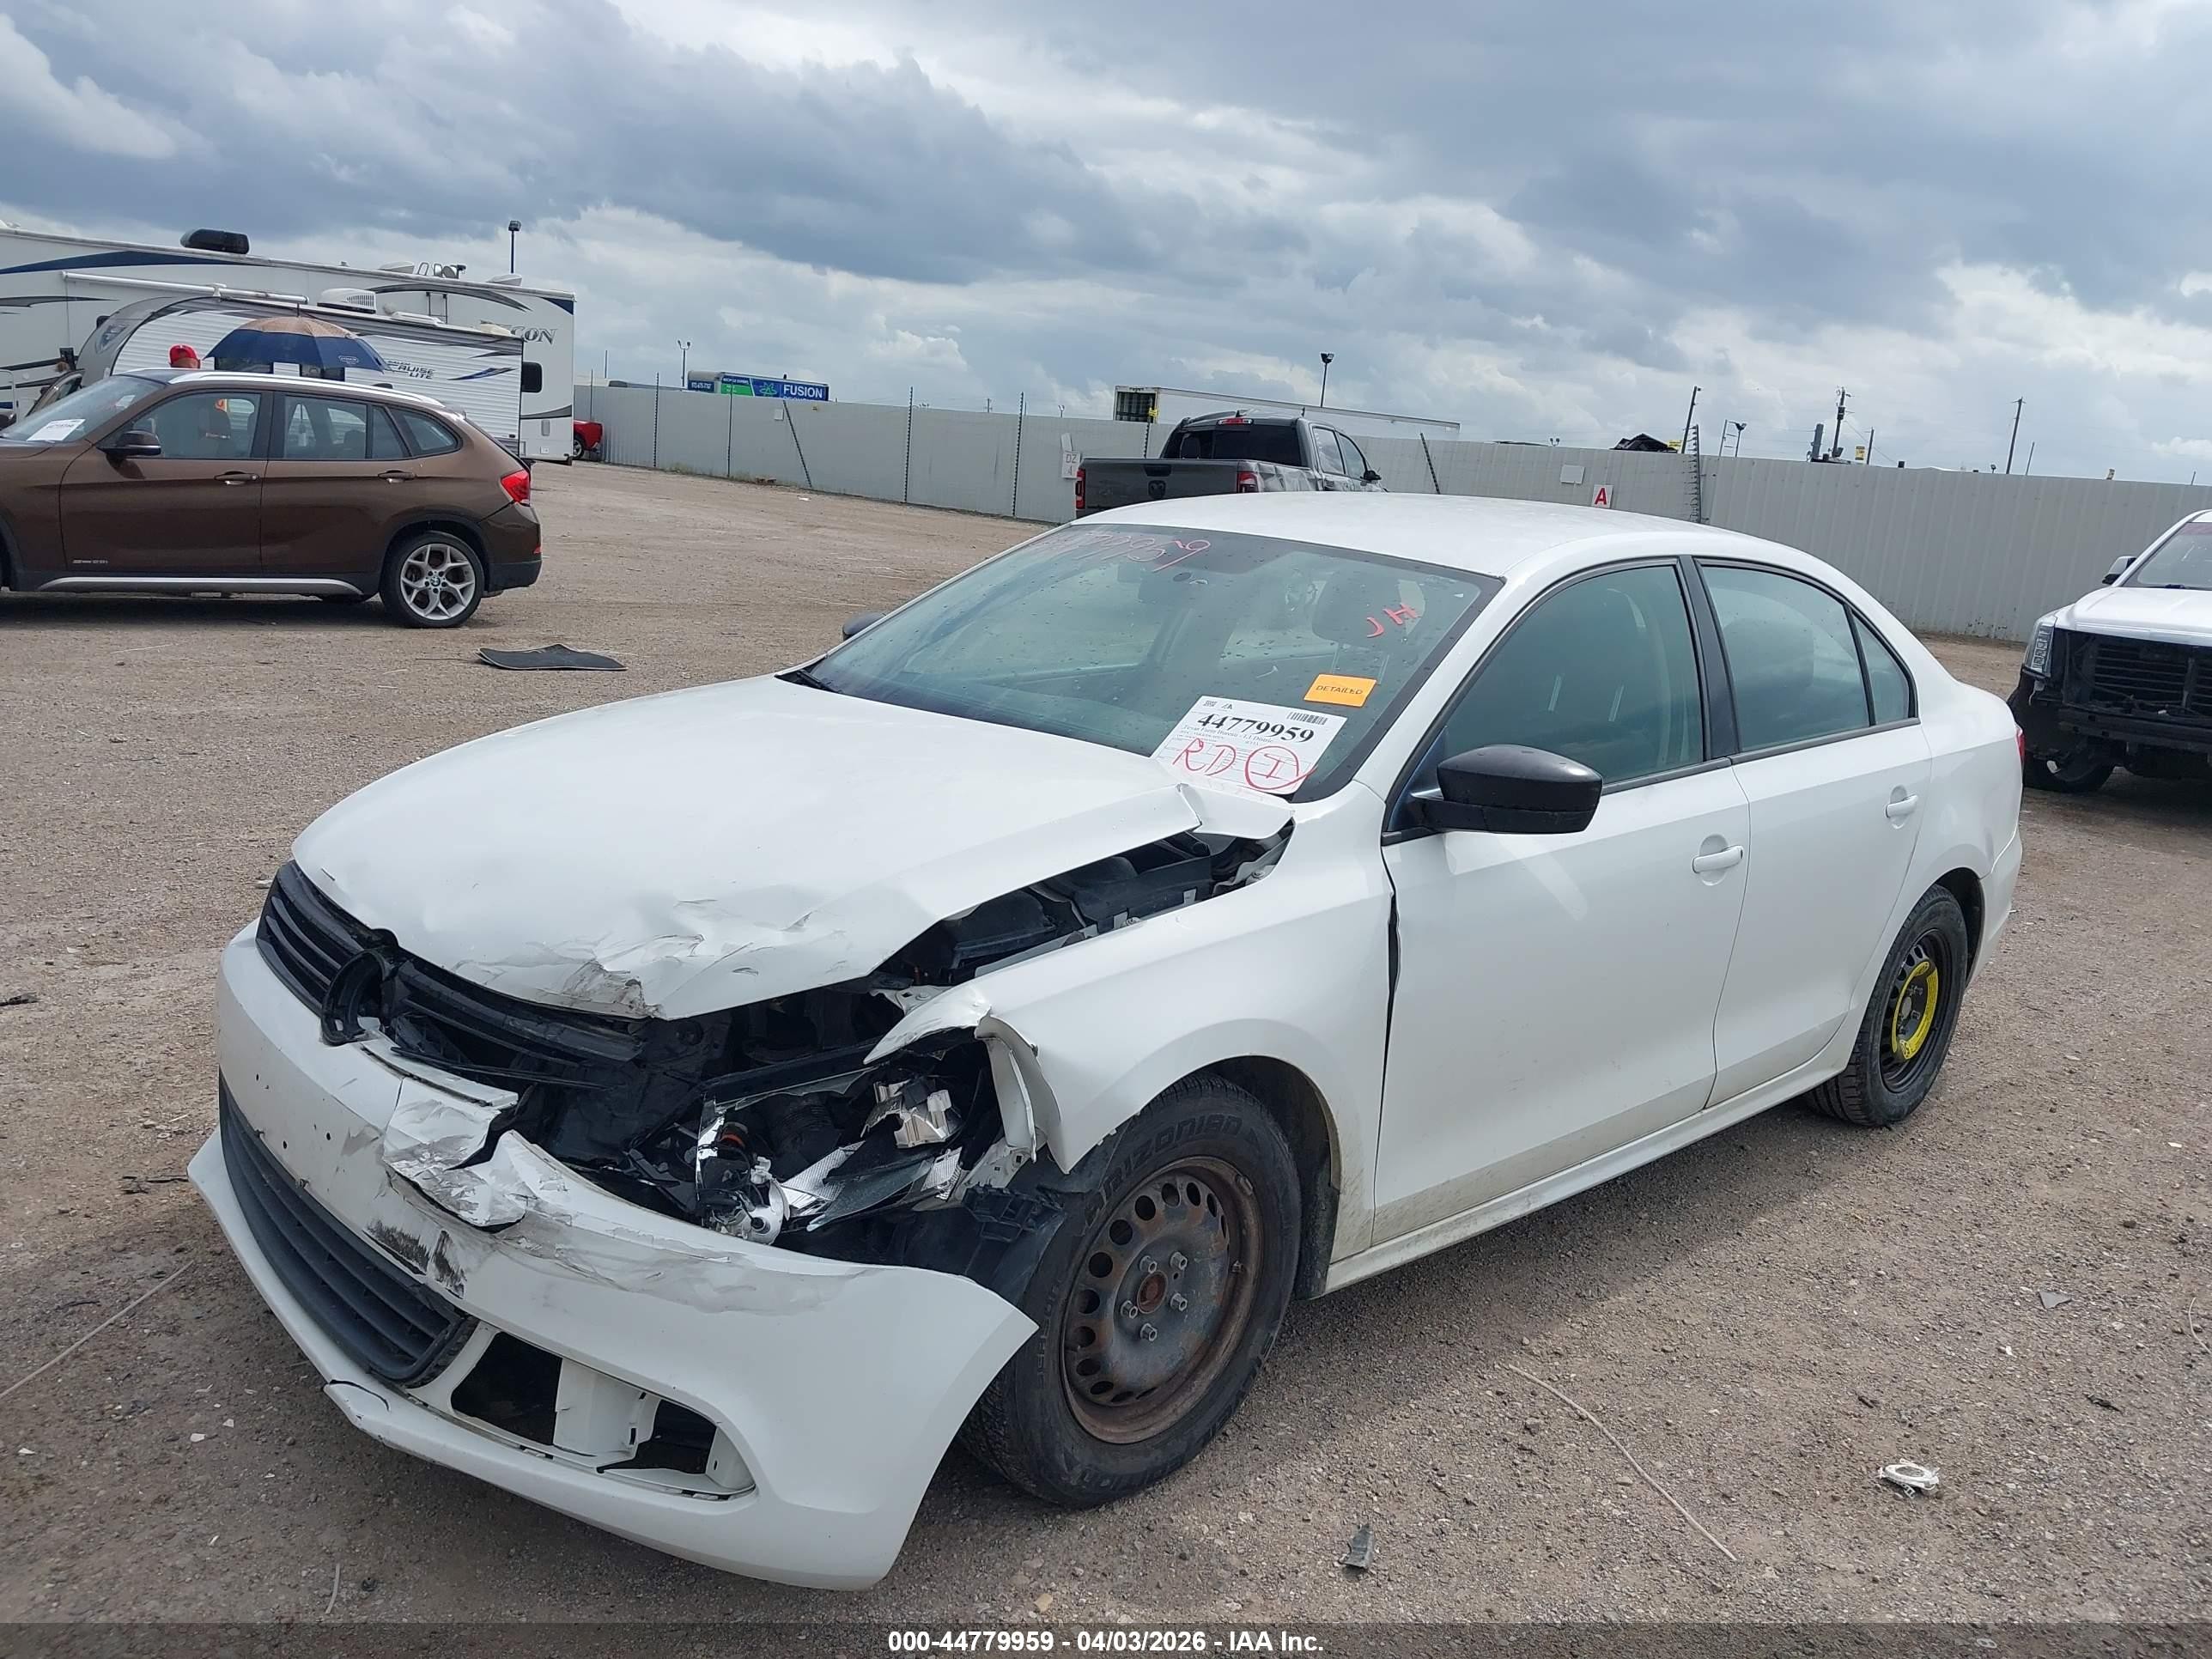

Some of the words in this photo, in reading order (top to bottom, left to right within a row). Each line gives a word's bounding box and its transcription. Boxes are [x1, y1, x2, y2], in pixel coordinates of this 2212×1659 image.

[409, 371, 434, 380] LITE
[783, 384, 823, 399] FUSION
[1594, 487, 1607, 505] A
[1316, 684, 1364, 696] DETAILED
[1196, 713, 1316, 744] 44779959
